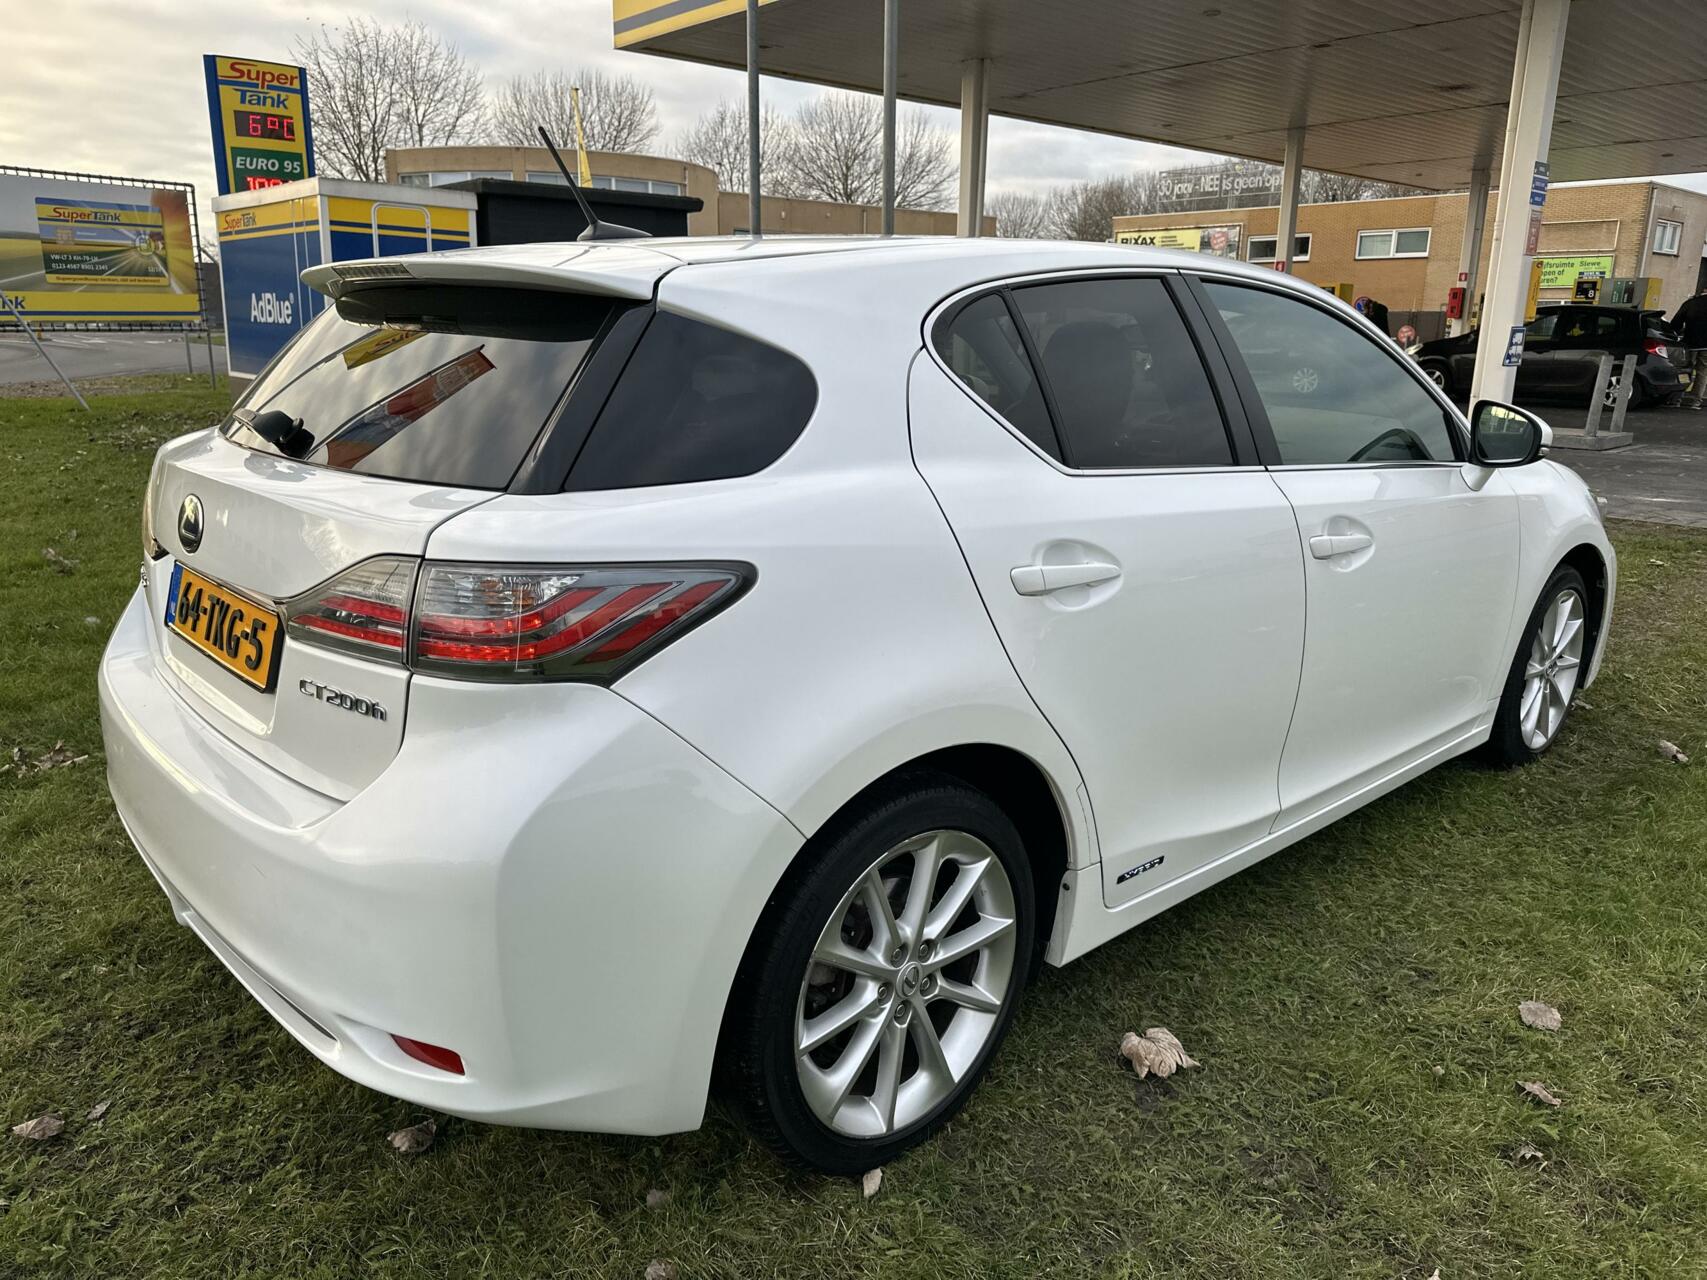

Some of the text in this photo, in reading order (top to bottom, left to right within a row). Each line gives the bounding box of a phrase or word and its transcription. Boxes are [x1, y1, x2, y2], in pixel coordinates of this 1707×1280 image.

[218, 61, 298, 89] Super
[233, 88, 289, 110] Tank
[235, 156, 301, 174] EURO 95
[1200, 175, 1220, 192] NEE
[1222, 174, 1232, 191] is
[1233, 175, 1262, 195] geen
[48, 207, 121, 223] SuperTank
[223, 211, 257, 232] SuperTank
[1588, 290, 1595, 298] 8
[177, 580, 267, 671] 64-TKG-5
[299, 679, 388, 722] CT200h
